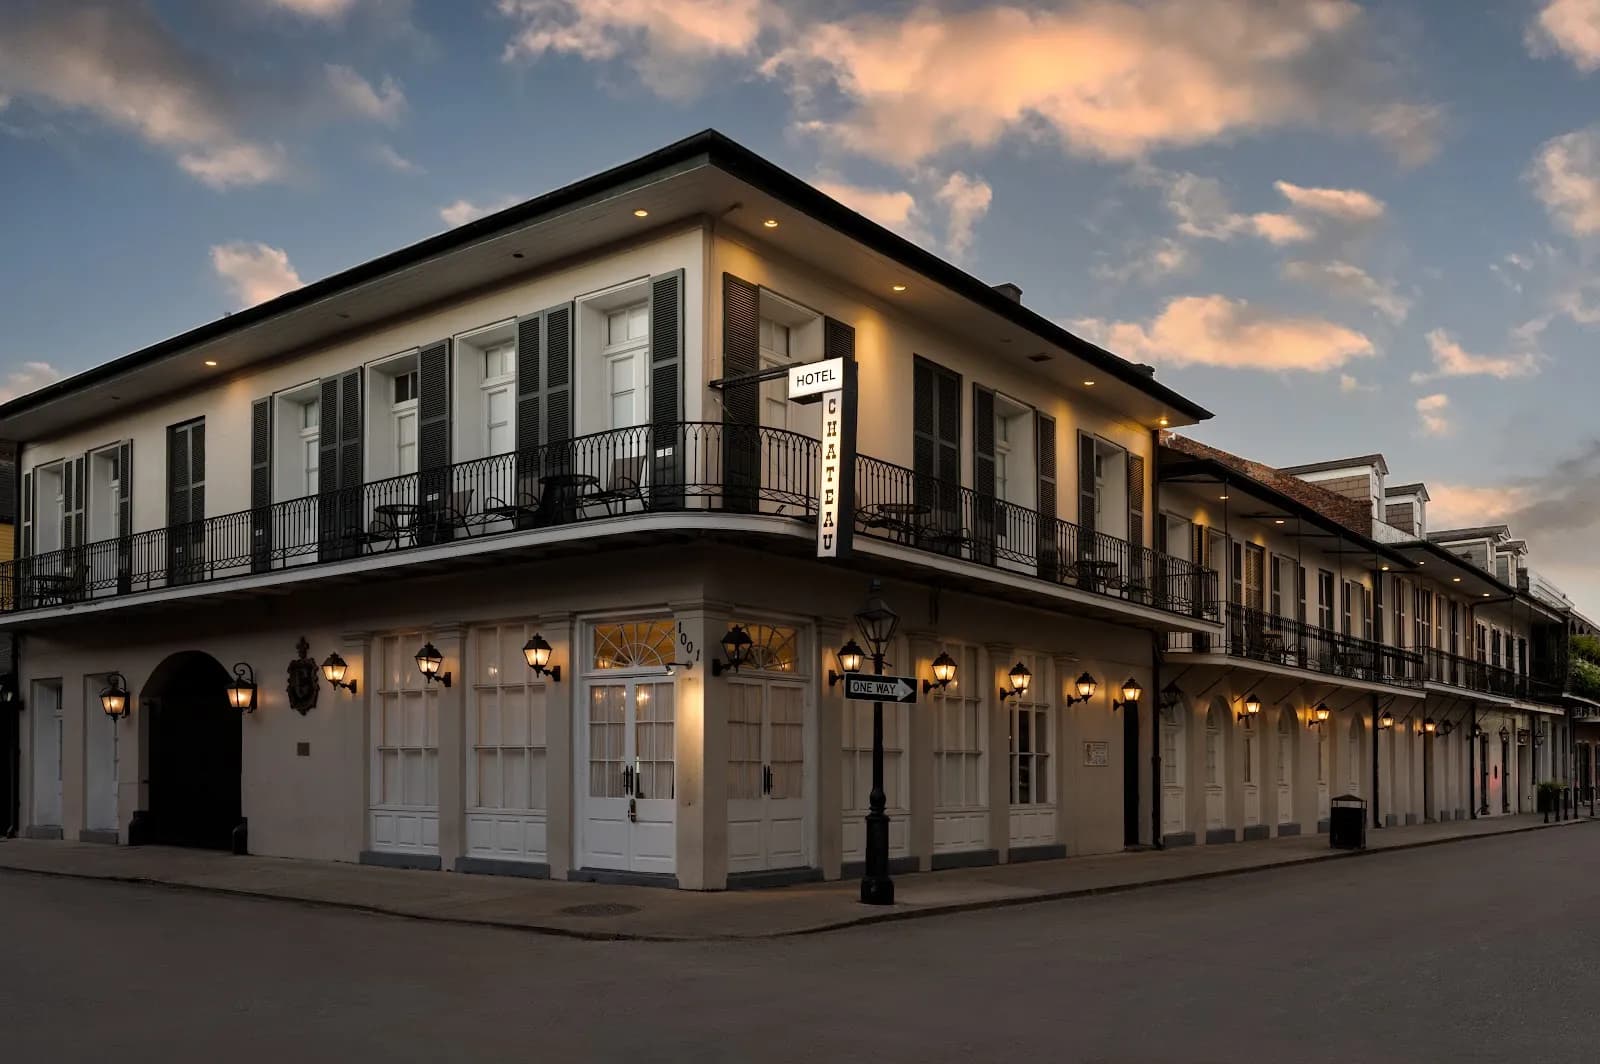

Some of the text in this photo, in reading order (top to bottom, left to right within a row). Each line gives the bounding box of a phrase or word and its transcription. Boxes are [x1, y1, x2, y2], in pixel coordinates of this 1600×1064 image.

[796, 368, 837, 388] HOTEL
[823, 398, 838, 550] CHATEAU
[678, 621, 700, 662] 1001
[852, 681, 896, 695] ONE WAY
